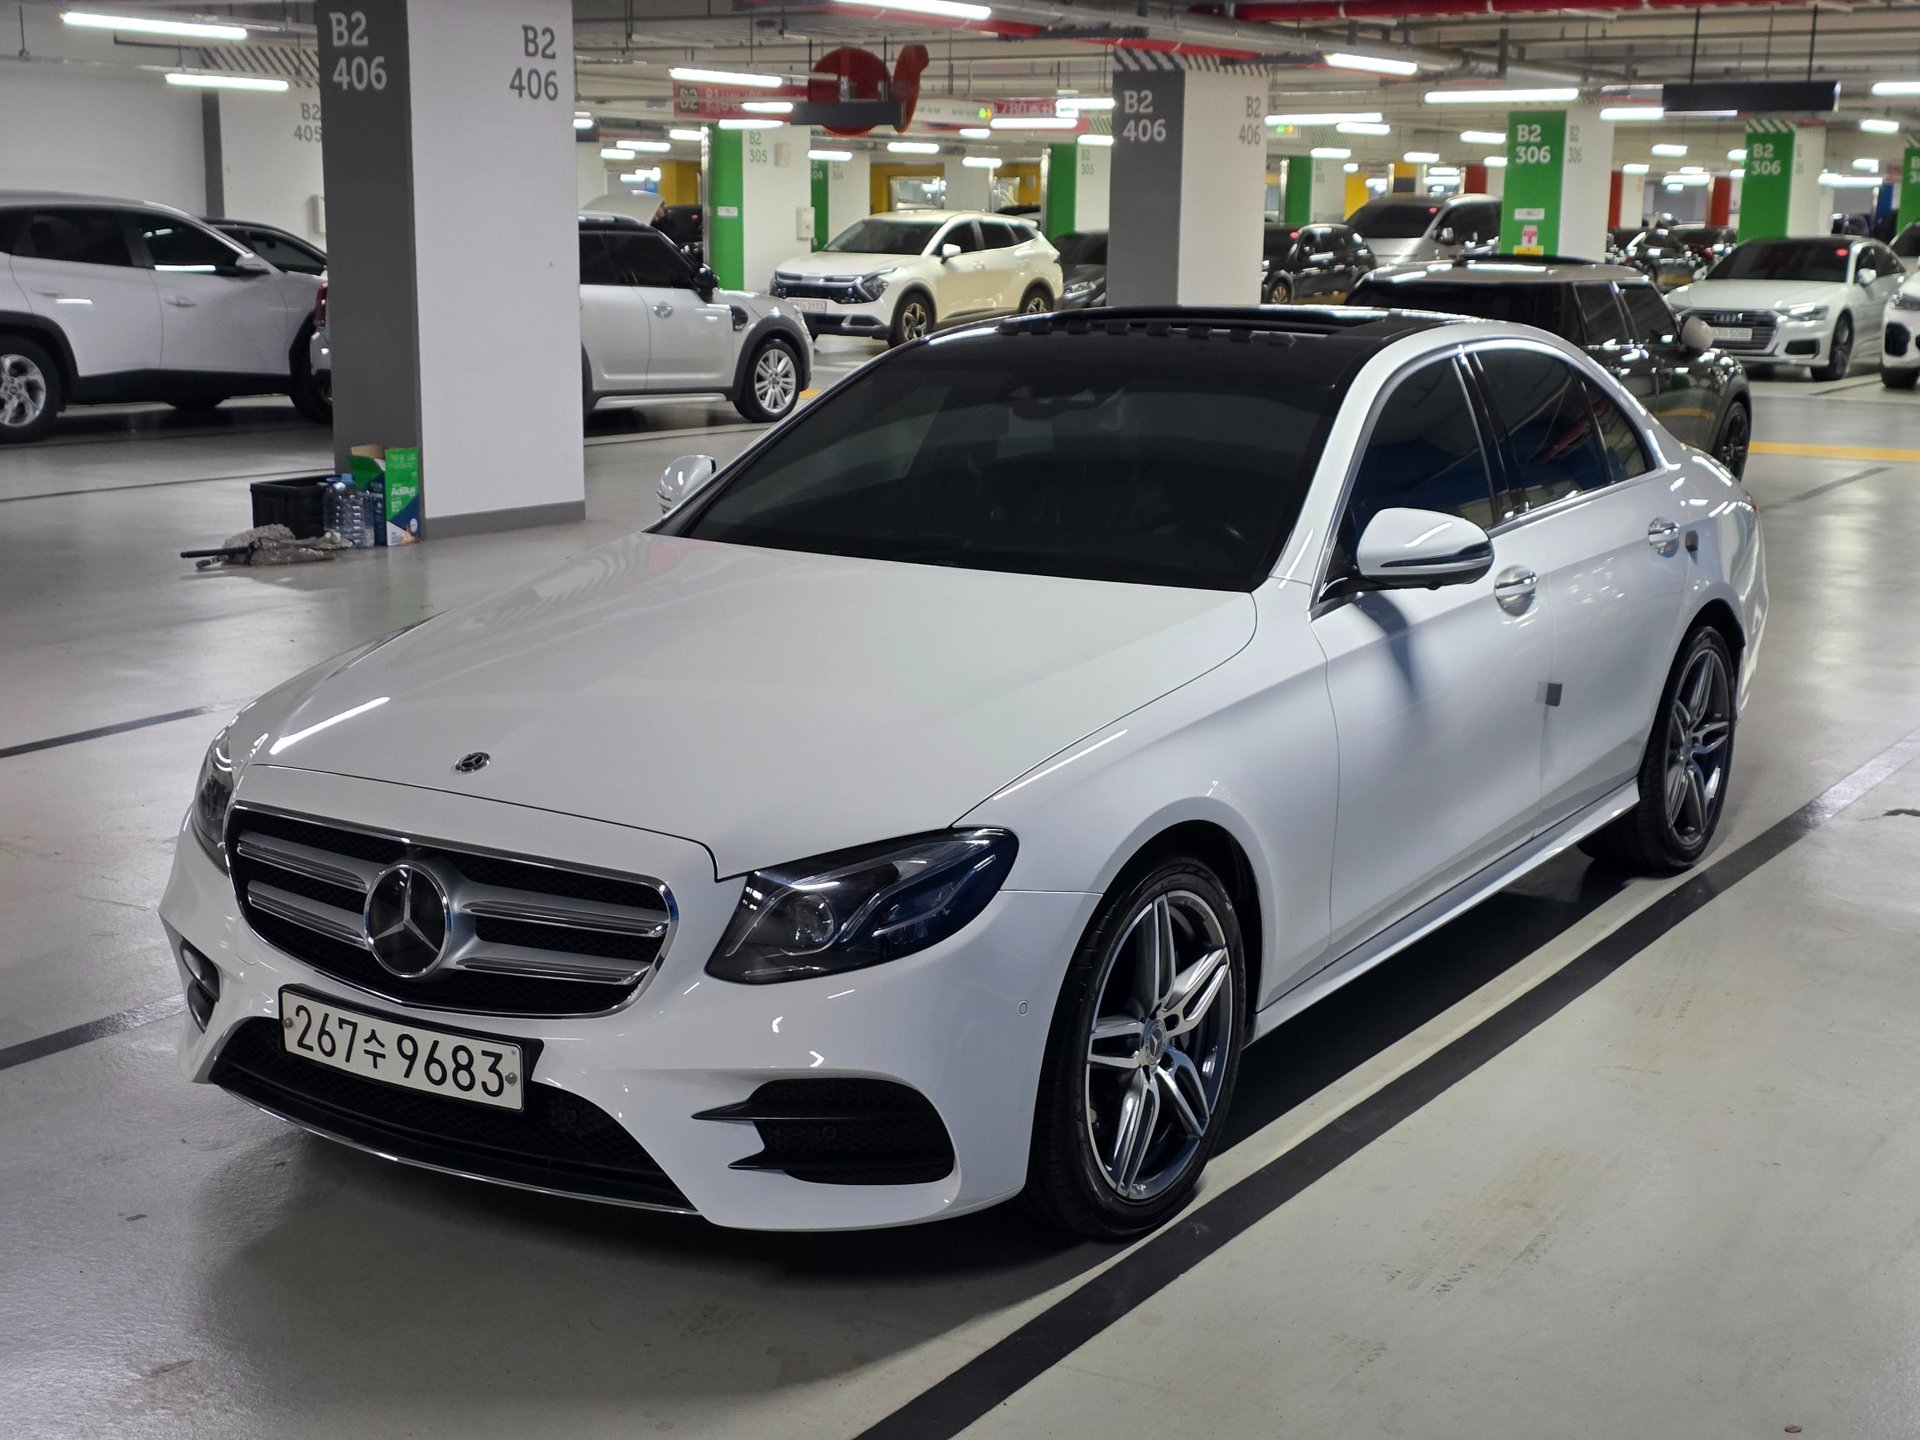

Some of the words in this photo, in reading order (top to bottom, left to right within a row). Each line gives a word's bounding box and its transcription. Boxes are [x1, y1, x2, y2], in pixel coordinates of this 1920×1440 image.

[329, 11, 368, 46] B2
[522, 24, 556, 59] B2
[332, 56, 387, 90] 406
[509, 67, 558, 100] 406
[301, 103, 321, 120] B2
[1124, 90, 1153, 113] B2
[1247, 96, 1261, 117] B2
[294, 124, 322, 142] 405
[749, 131, 762, 145] B2
[1122, 119, 1166, 142] 406
[1239, 124, 1261, 145] 406
[1517, 124, 1541, 142] B2
[749, 149, 767, 162] 305
[1515, 146, 1551, 163] 306
[1753, 143, 1774, 157] B2
[1751, 161, 1781, 176] 306
[295, 1004, 504, 1097] 267수9683
